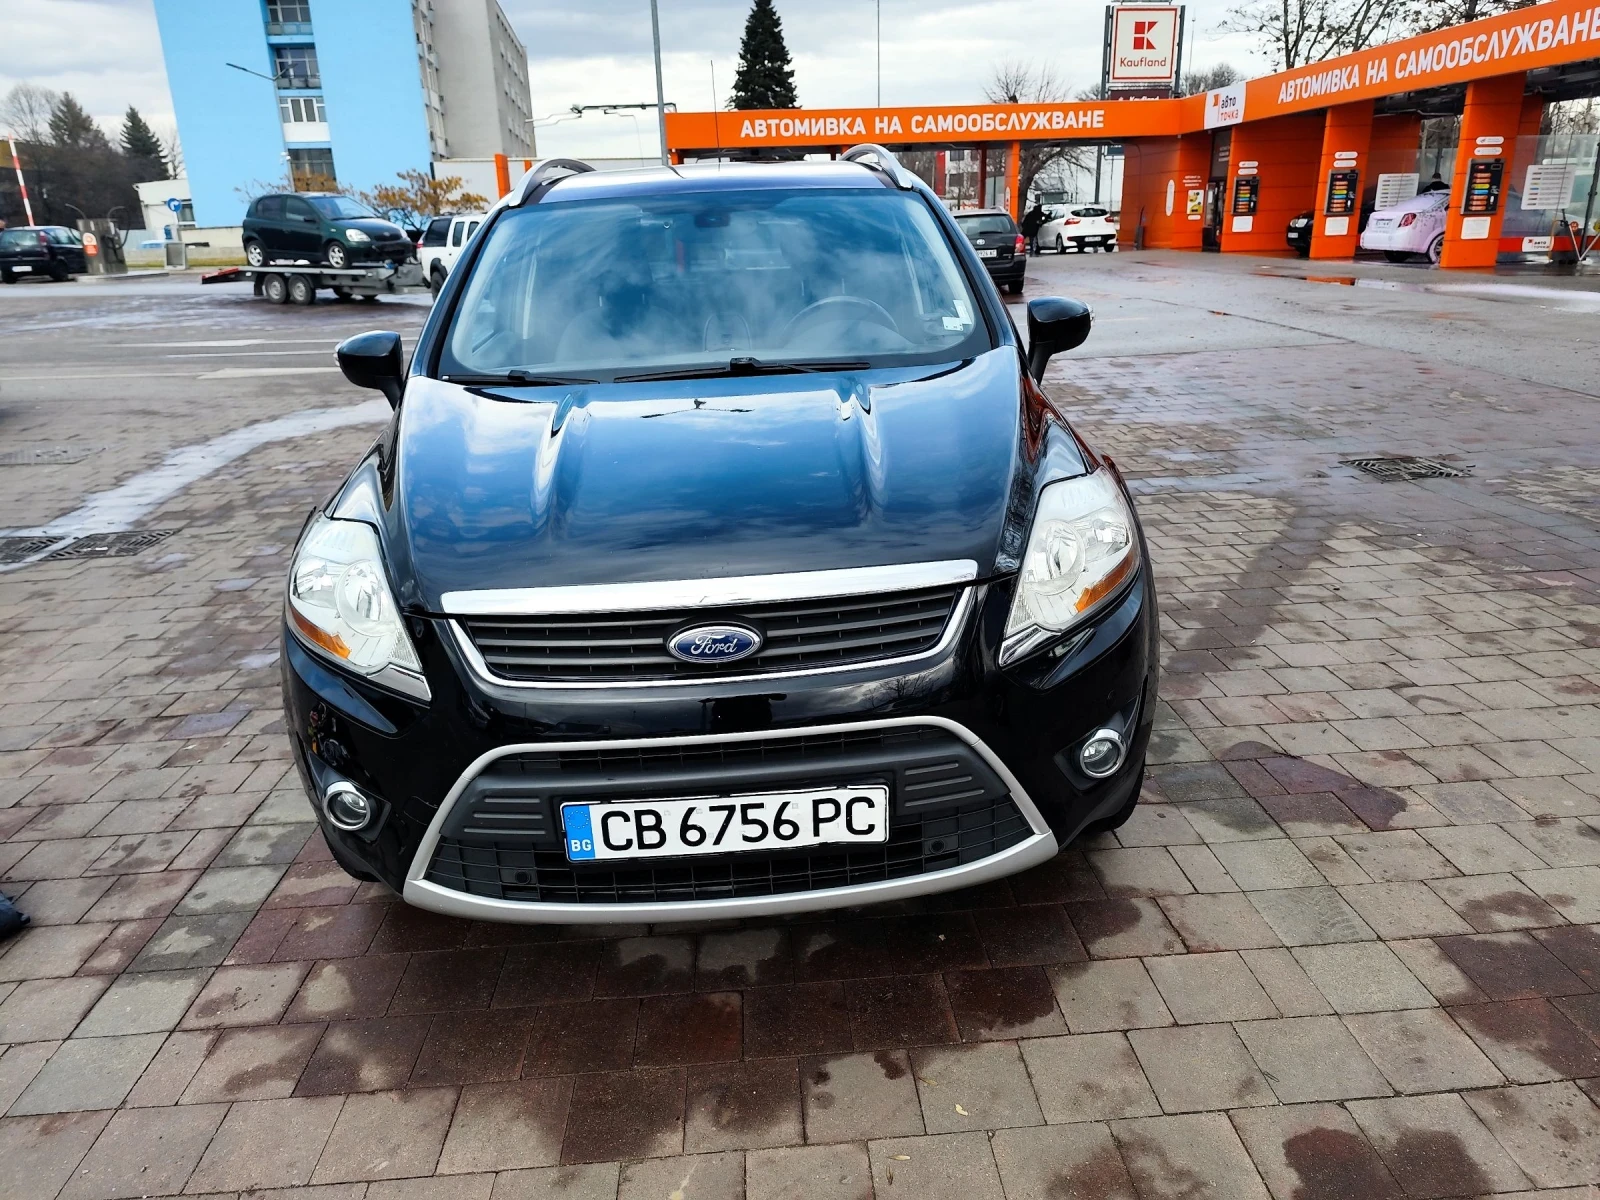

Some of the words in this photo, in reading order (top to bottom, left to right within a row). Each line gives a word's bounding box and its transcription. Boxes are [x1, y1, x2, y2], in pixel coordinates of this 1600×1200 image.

[1120, 56, 1166, 67] Kaufland
[1277, 63, 1360, 105] АВТОМИВКА
[1365, 57, 1388, 86] НА
[1394, 7, 1600, 80] САМООБСЛУЖВАНЕ
[740, 115, 867, 138] АВТОМИВКА
[875, 116, 903, 135] НА
[911, 109, 1105, 134] САМООБСЛУЖВАНЕ
[690, 634, 738, 655] Ford
[601, 809, 668, 852] CB
[679, 801, 800, 847] 6756
[812, 796, 876, 838] PC
[571, 838, 592, 852] BG
